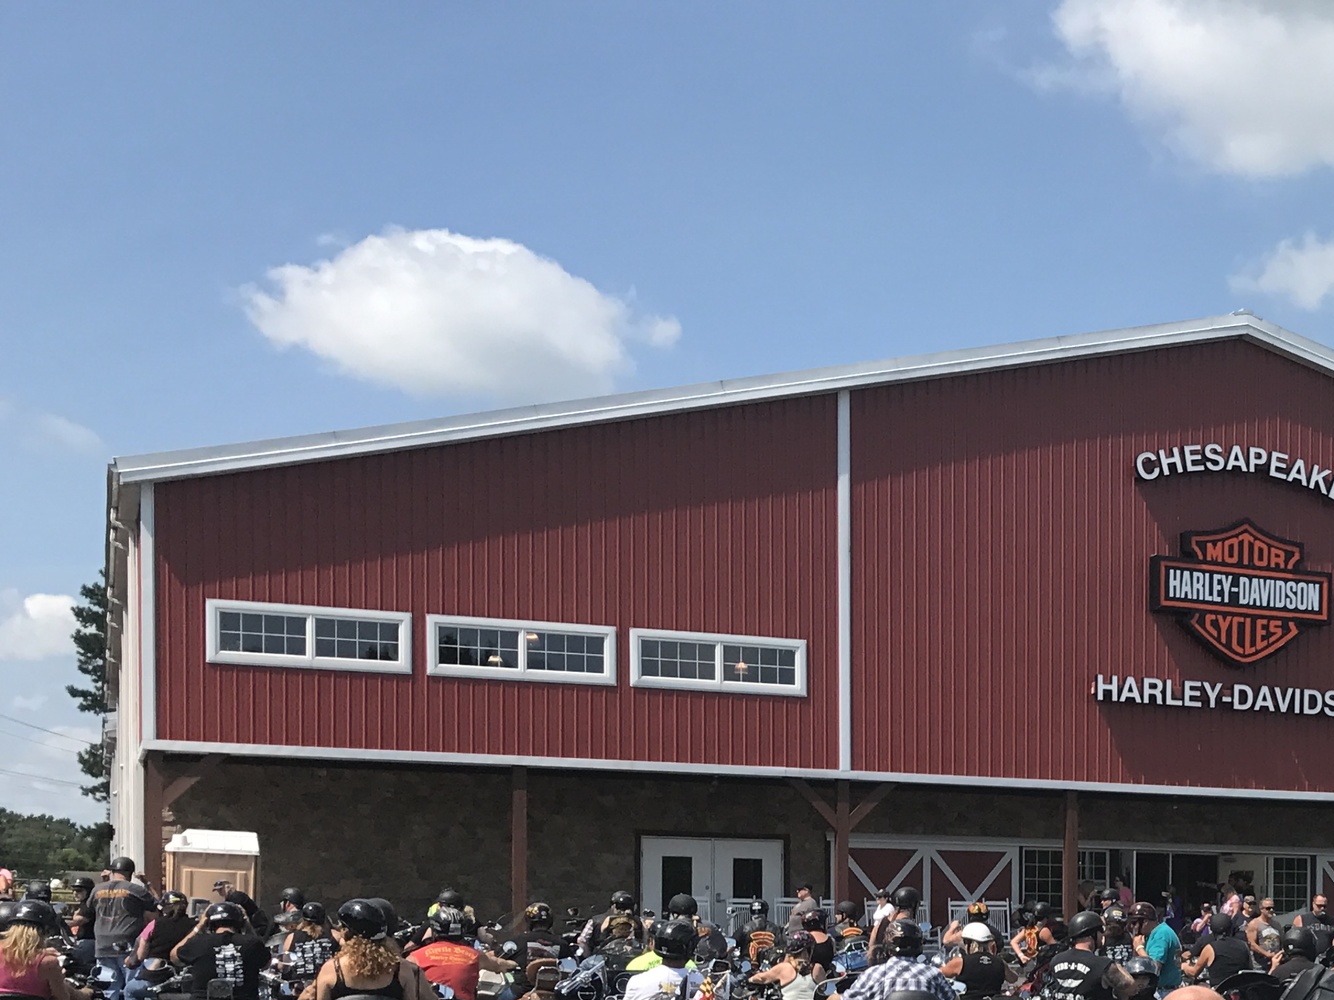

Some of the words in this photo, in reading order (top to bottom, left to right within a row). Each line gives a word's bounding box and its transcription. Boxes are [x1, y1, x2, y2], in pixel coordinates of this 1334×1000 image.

[1206, 534, 1286, 569] MOTOR
[1168, 568, 1320, 611] HARLEY-DAVIDSON
[1205, 614, 1283, 654] CYCLES
